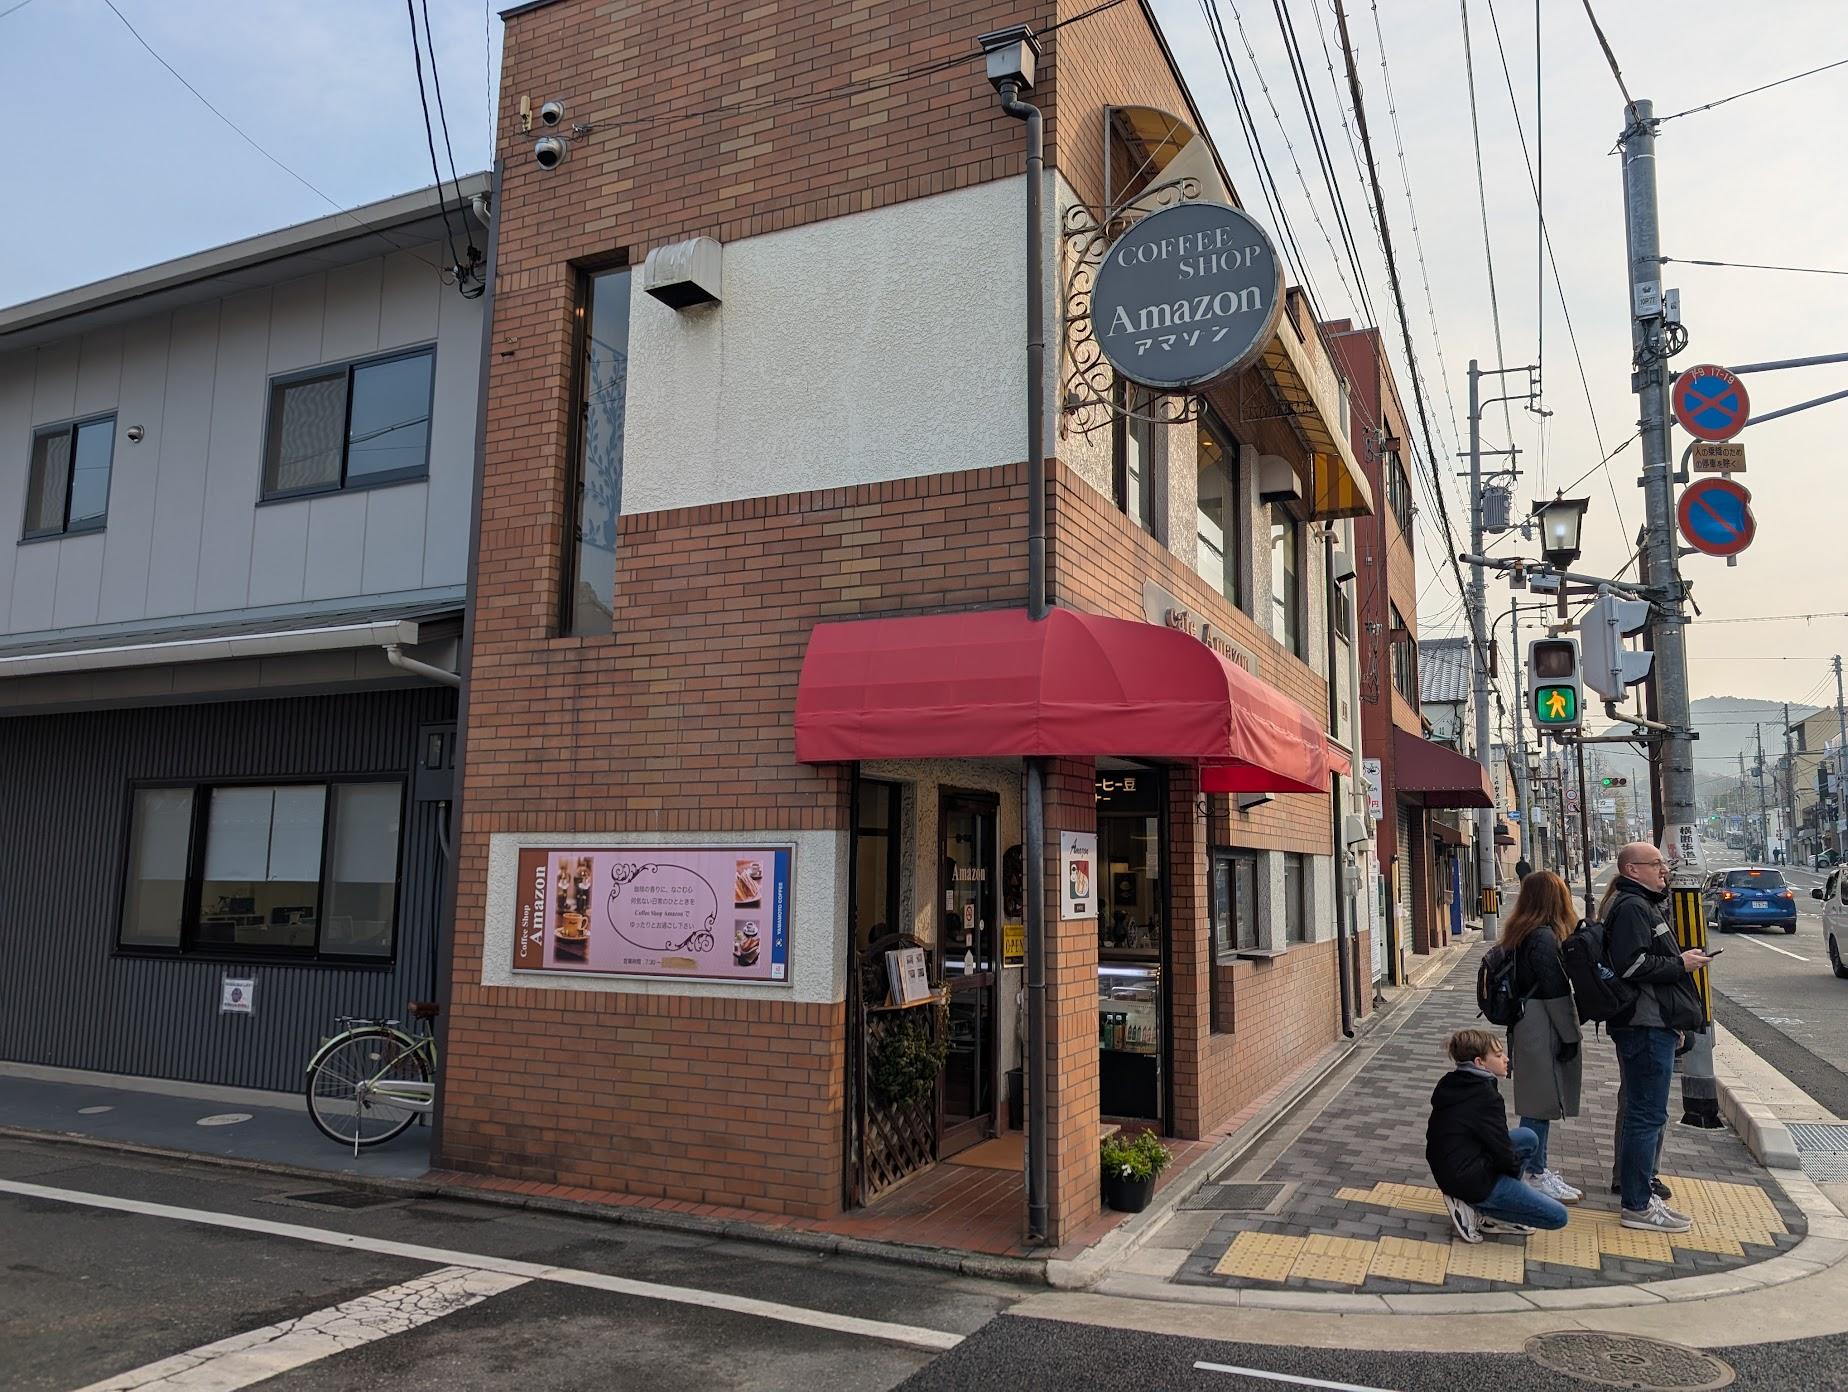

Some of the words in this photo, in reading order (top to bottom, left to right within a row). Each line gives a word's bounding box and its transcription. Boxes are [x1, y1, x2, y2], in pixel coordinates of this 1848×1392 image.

[1118, 226, 1233, 267] COFFEE
[1178, 245, 1261, 279] SHOP
[1106, 285, 1262, 337] Amazon
[1134, 326, 1230, 356] アマゾン
[1711, 368, 1735, 385] 17-19
[1695, 447, 1743, 457] 人の乗降のため
[1695, 458, 1736, 469] の停車を除く
[1679, 826, 1698, 866] 横断歩道に
[952, 864, 986, 881] Amazon
[521, 904, 531, 928] Shop
[530, 866, 546, 946] Amazon
[520, 930, 529, 958] Coffee
[1006, 939, 1024, 953] OPEN
